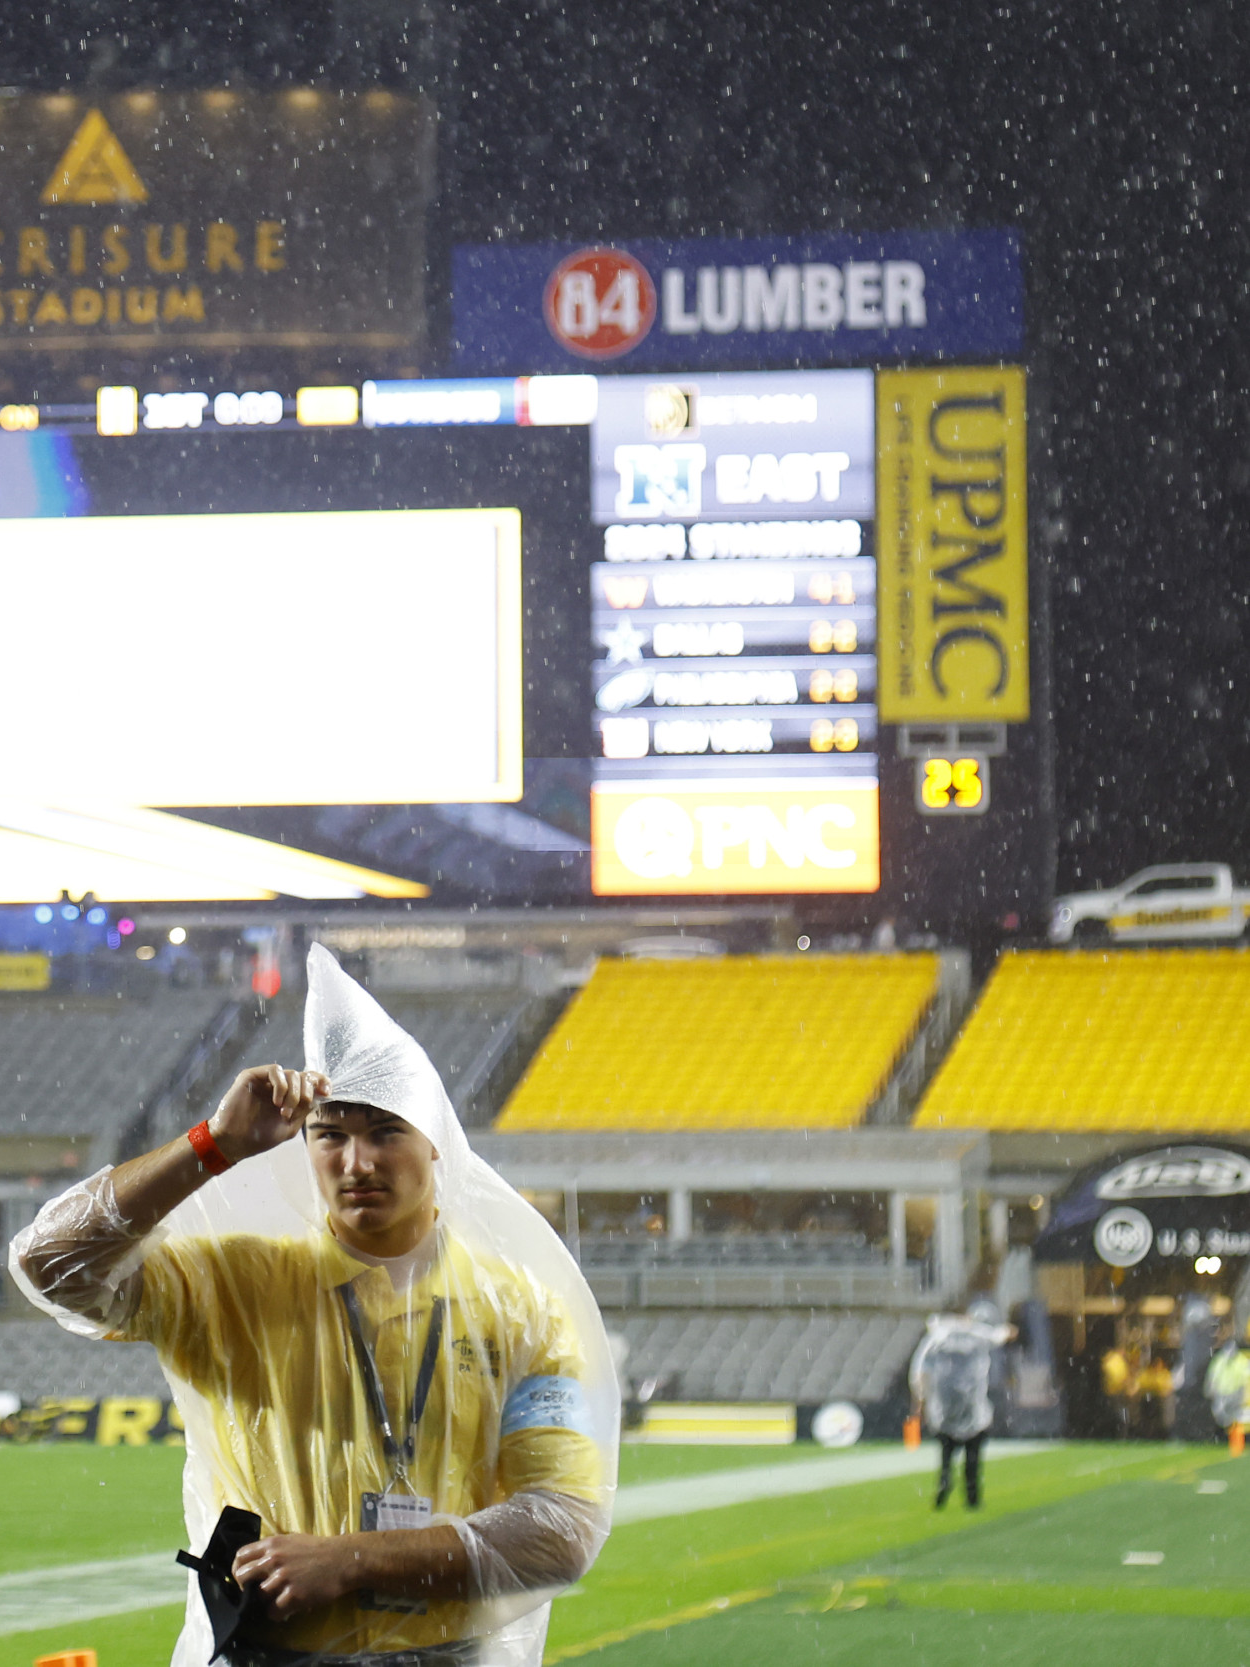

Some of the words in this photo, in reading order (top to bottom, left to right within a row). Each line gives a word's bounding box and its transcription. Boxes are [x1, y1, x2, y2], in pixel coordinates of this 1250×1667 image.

[556, 269, 641, 338] 84
[662, 259, 928, 335] LUMBER
[714, 451, 850, 505] EAST
[927, 385, 1009, 702] UPMC
[693, 802, 858, 870] PNC
